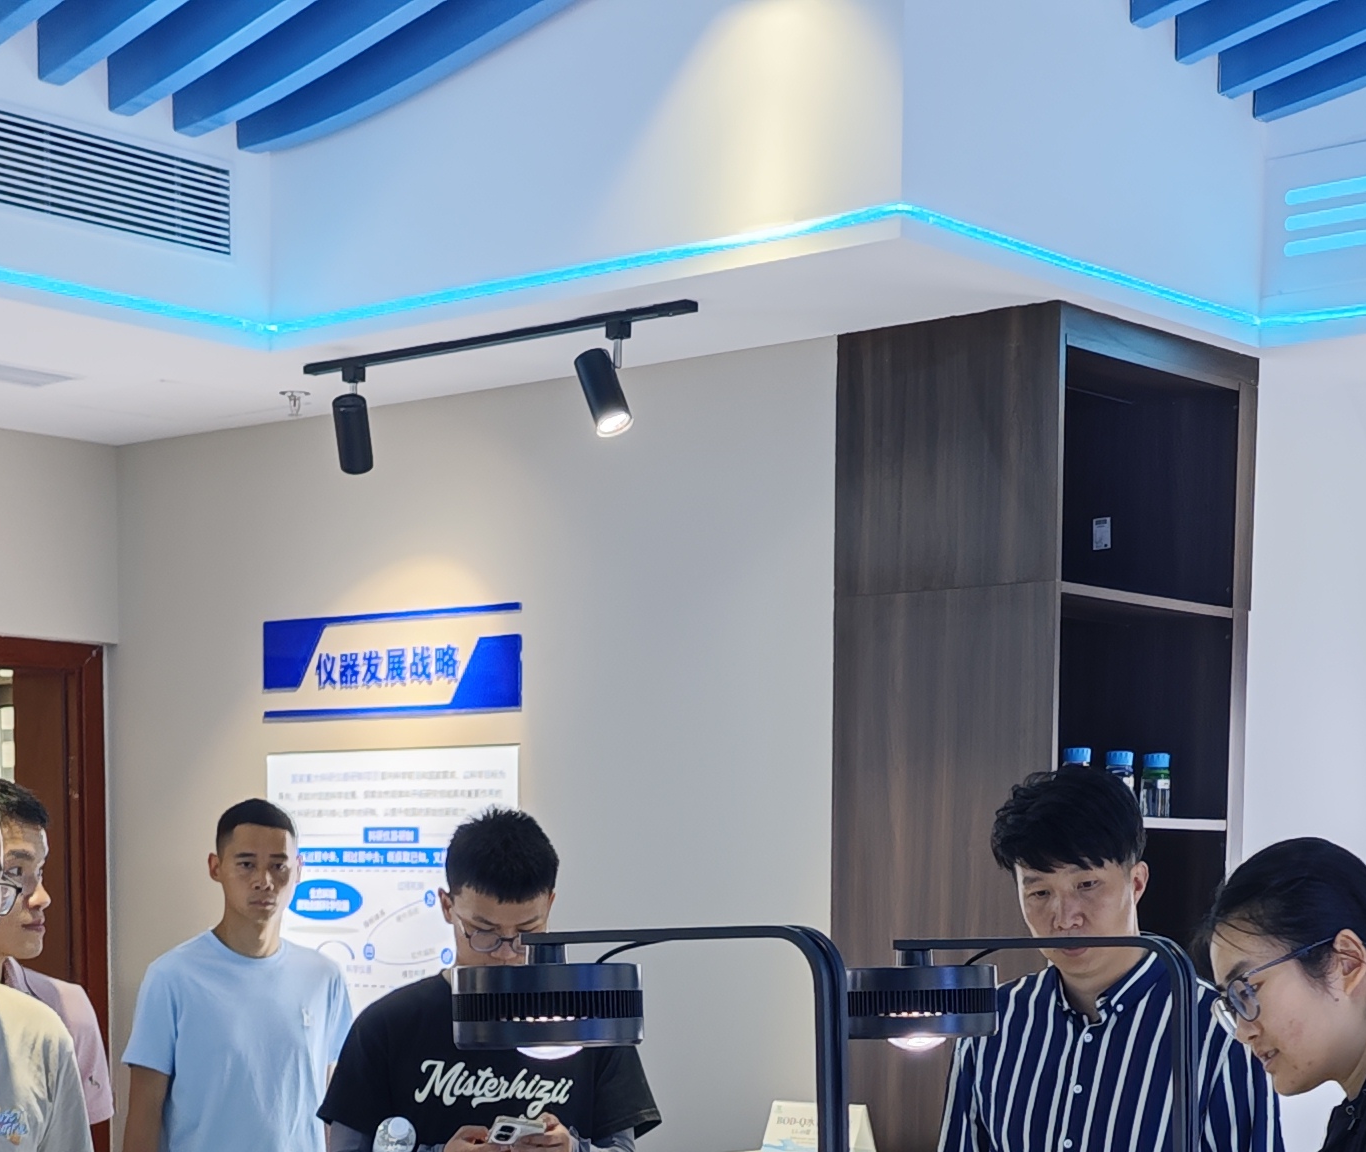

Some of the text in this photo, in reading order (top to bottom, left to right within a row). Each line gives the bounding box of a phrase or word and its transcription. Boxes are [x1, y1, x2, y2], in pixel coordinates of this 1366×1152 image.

[315, 644, 460, 687] 仪器发展战略
